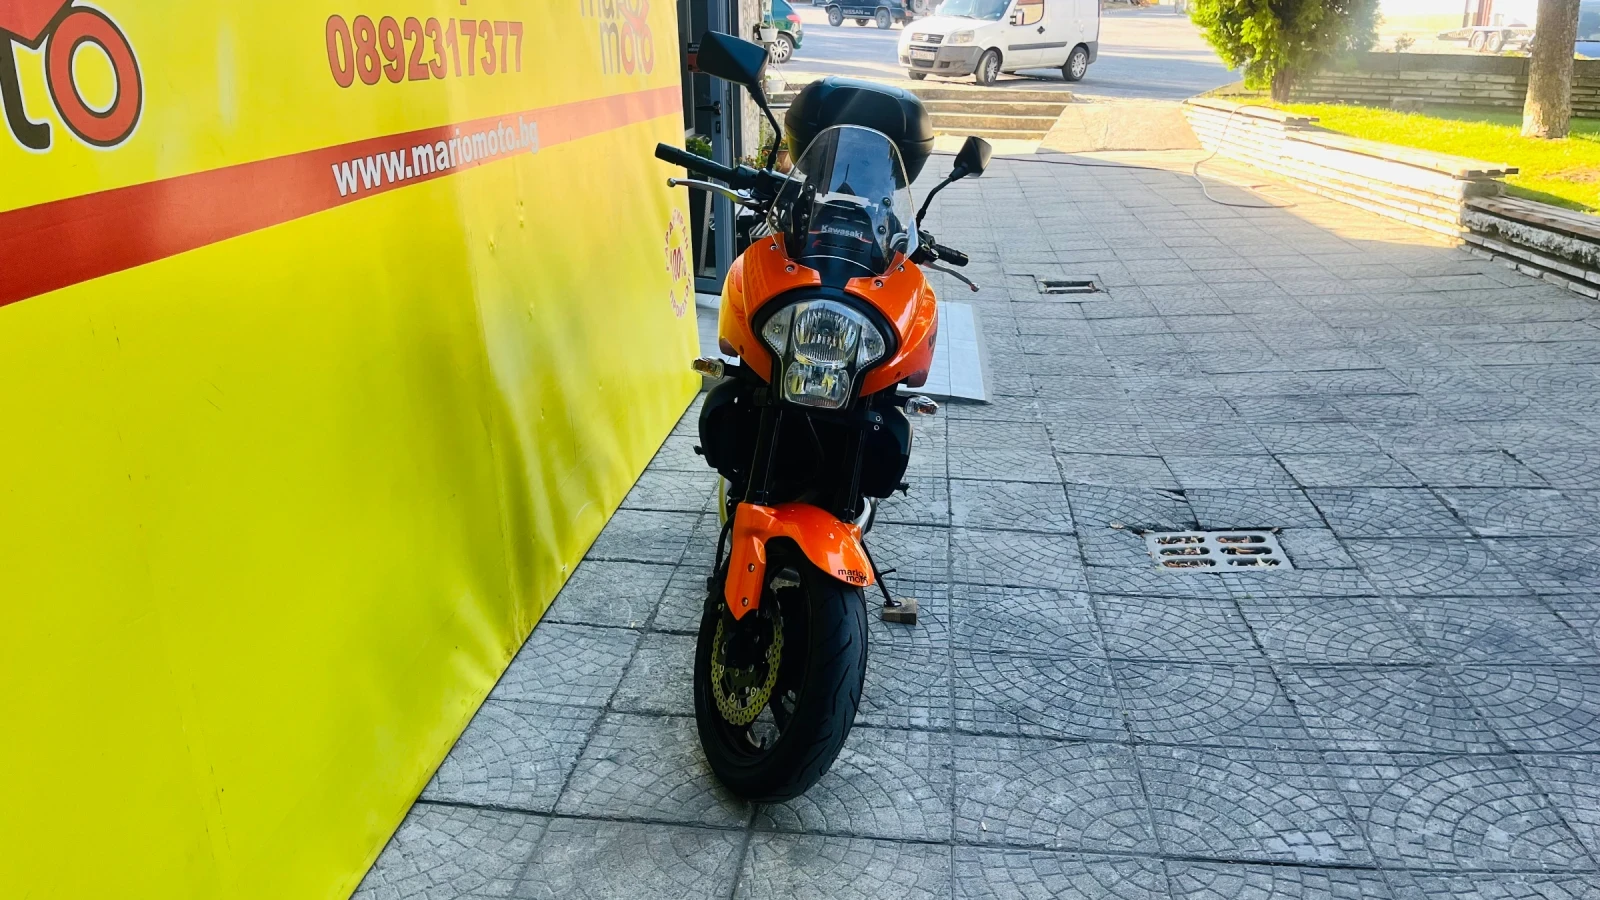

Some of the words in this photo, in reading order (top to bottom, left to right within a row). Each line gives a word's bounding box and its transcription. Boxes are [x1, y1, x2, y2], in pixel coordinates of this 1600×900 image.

[326, 14, 523, 88] 0892317377
[600, 22, 654, 75] moto
[331, 115, 539, 197] www.mariomoto.bg
[821, 224, 863, 239] Kawasaki
